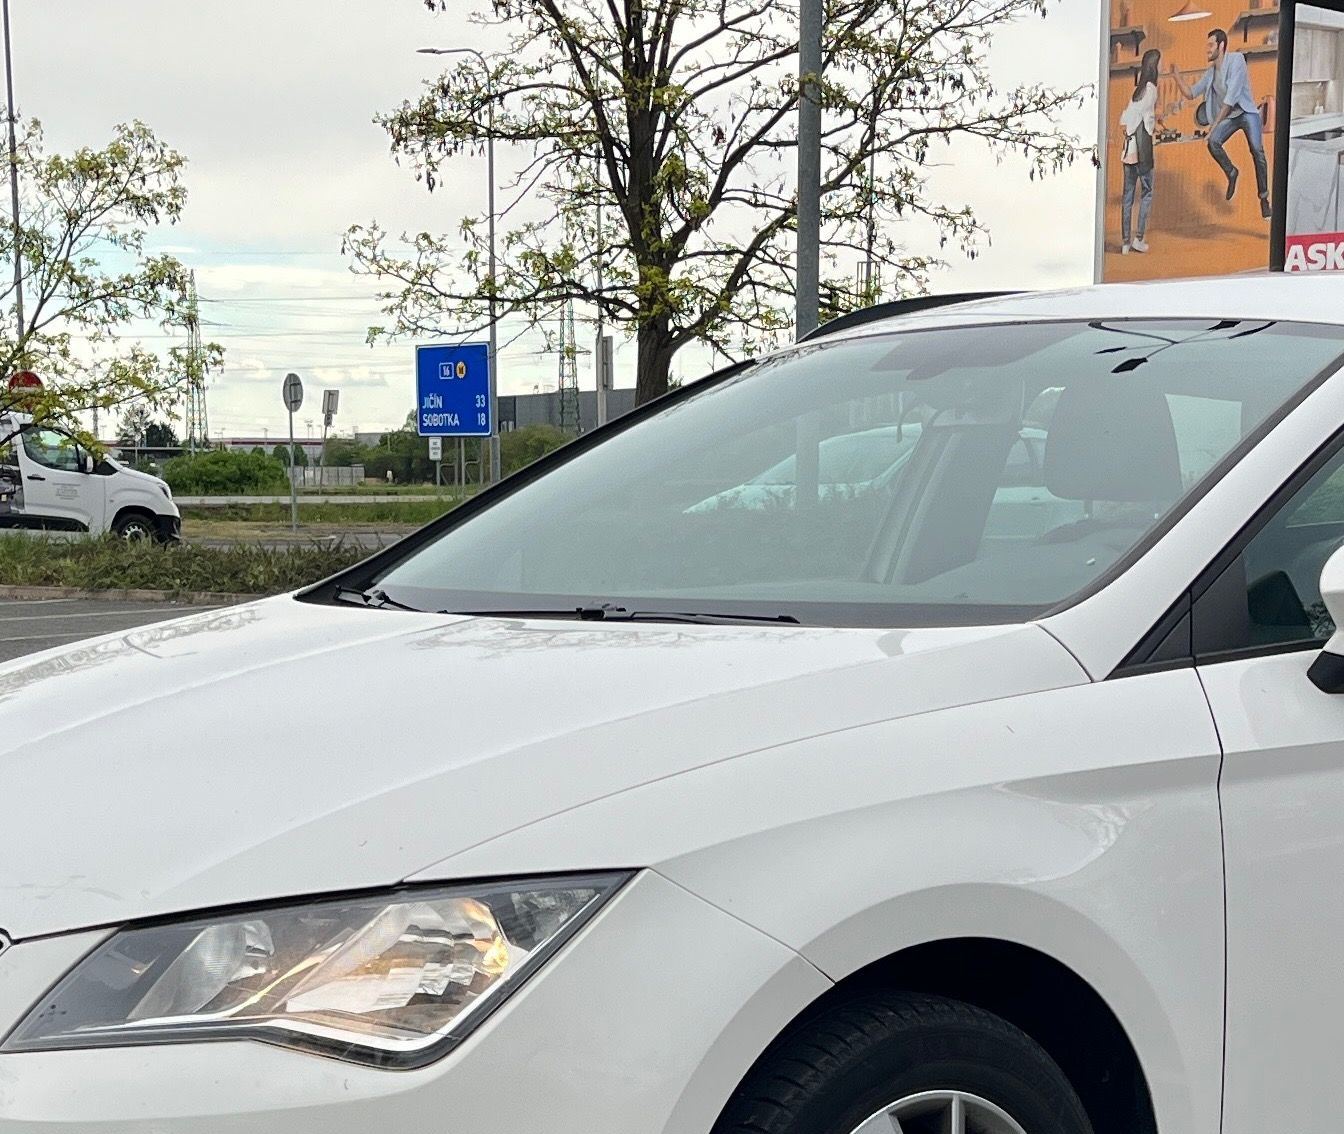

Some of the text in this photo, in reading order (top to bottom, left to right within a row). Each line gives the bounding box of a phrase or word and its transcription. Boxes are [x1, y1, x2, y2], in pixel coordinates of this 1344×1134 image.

[422, 393, 486, 409] JIČÍN 33
[422, 413, 486, 427] SOBOTKA 18
